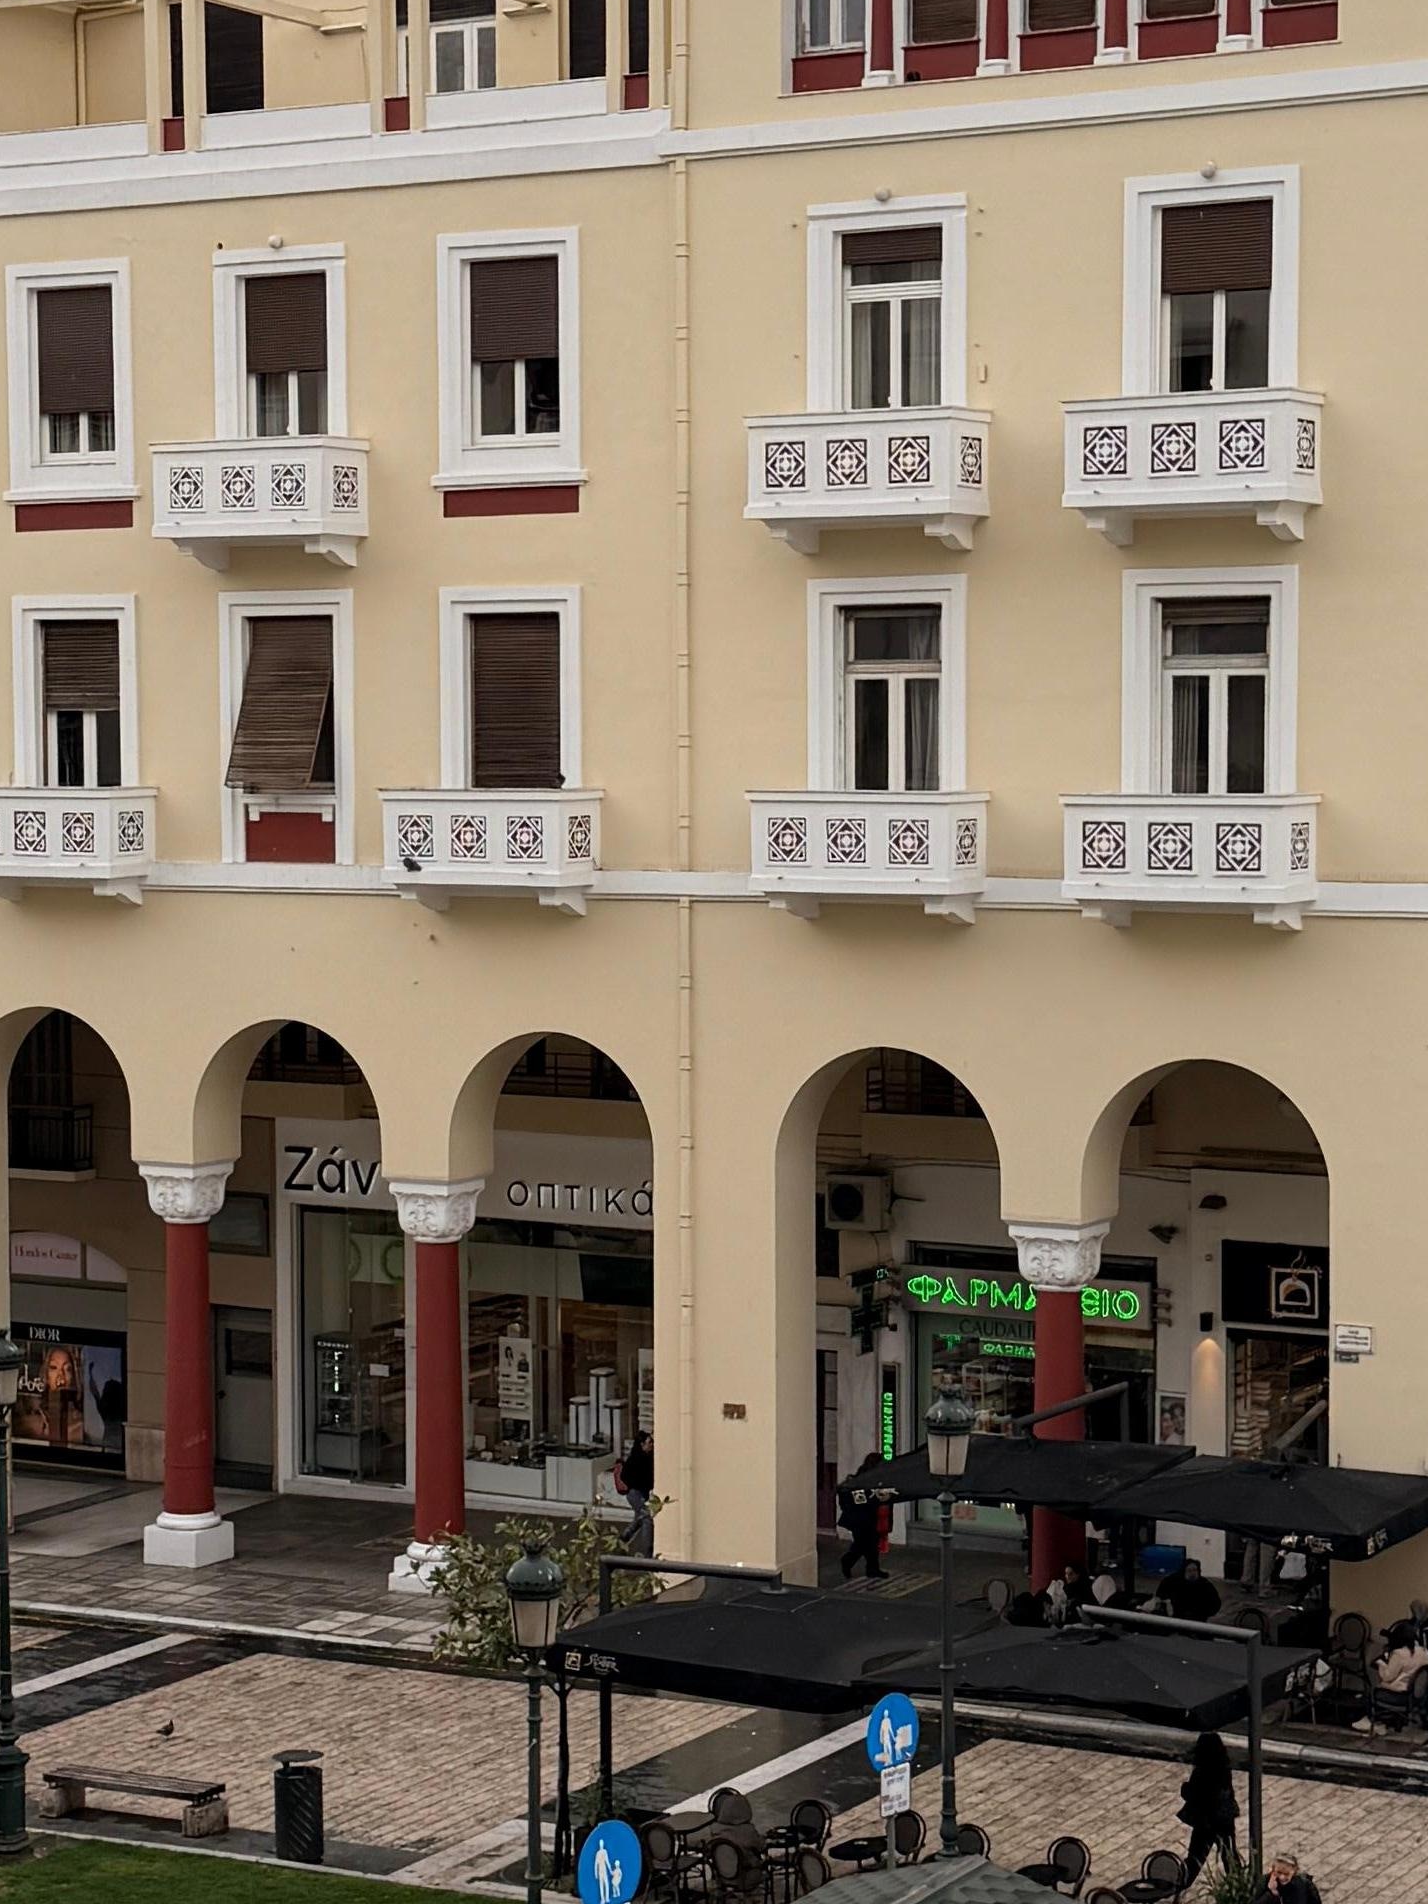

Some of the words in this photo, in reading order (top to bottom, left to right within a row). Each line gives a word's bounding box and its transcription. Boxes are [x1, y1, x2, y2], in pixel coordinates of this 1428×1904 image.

[283, 1145, 380, 1196] Ζάν
[907, 1275, 1140, 1320] ΦΑΡΜΑΕΙΟ
[29, 1326, 61, 1342] DIOR
